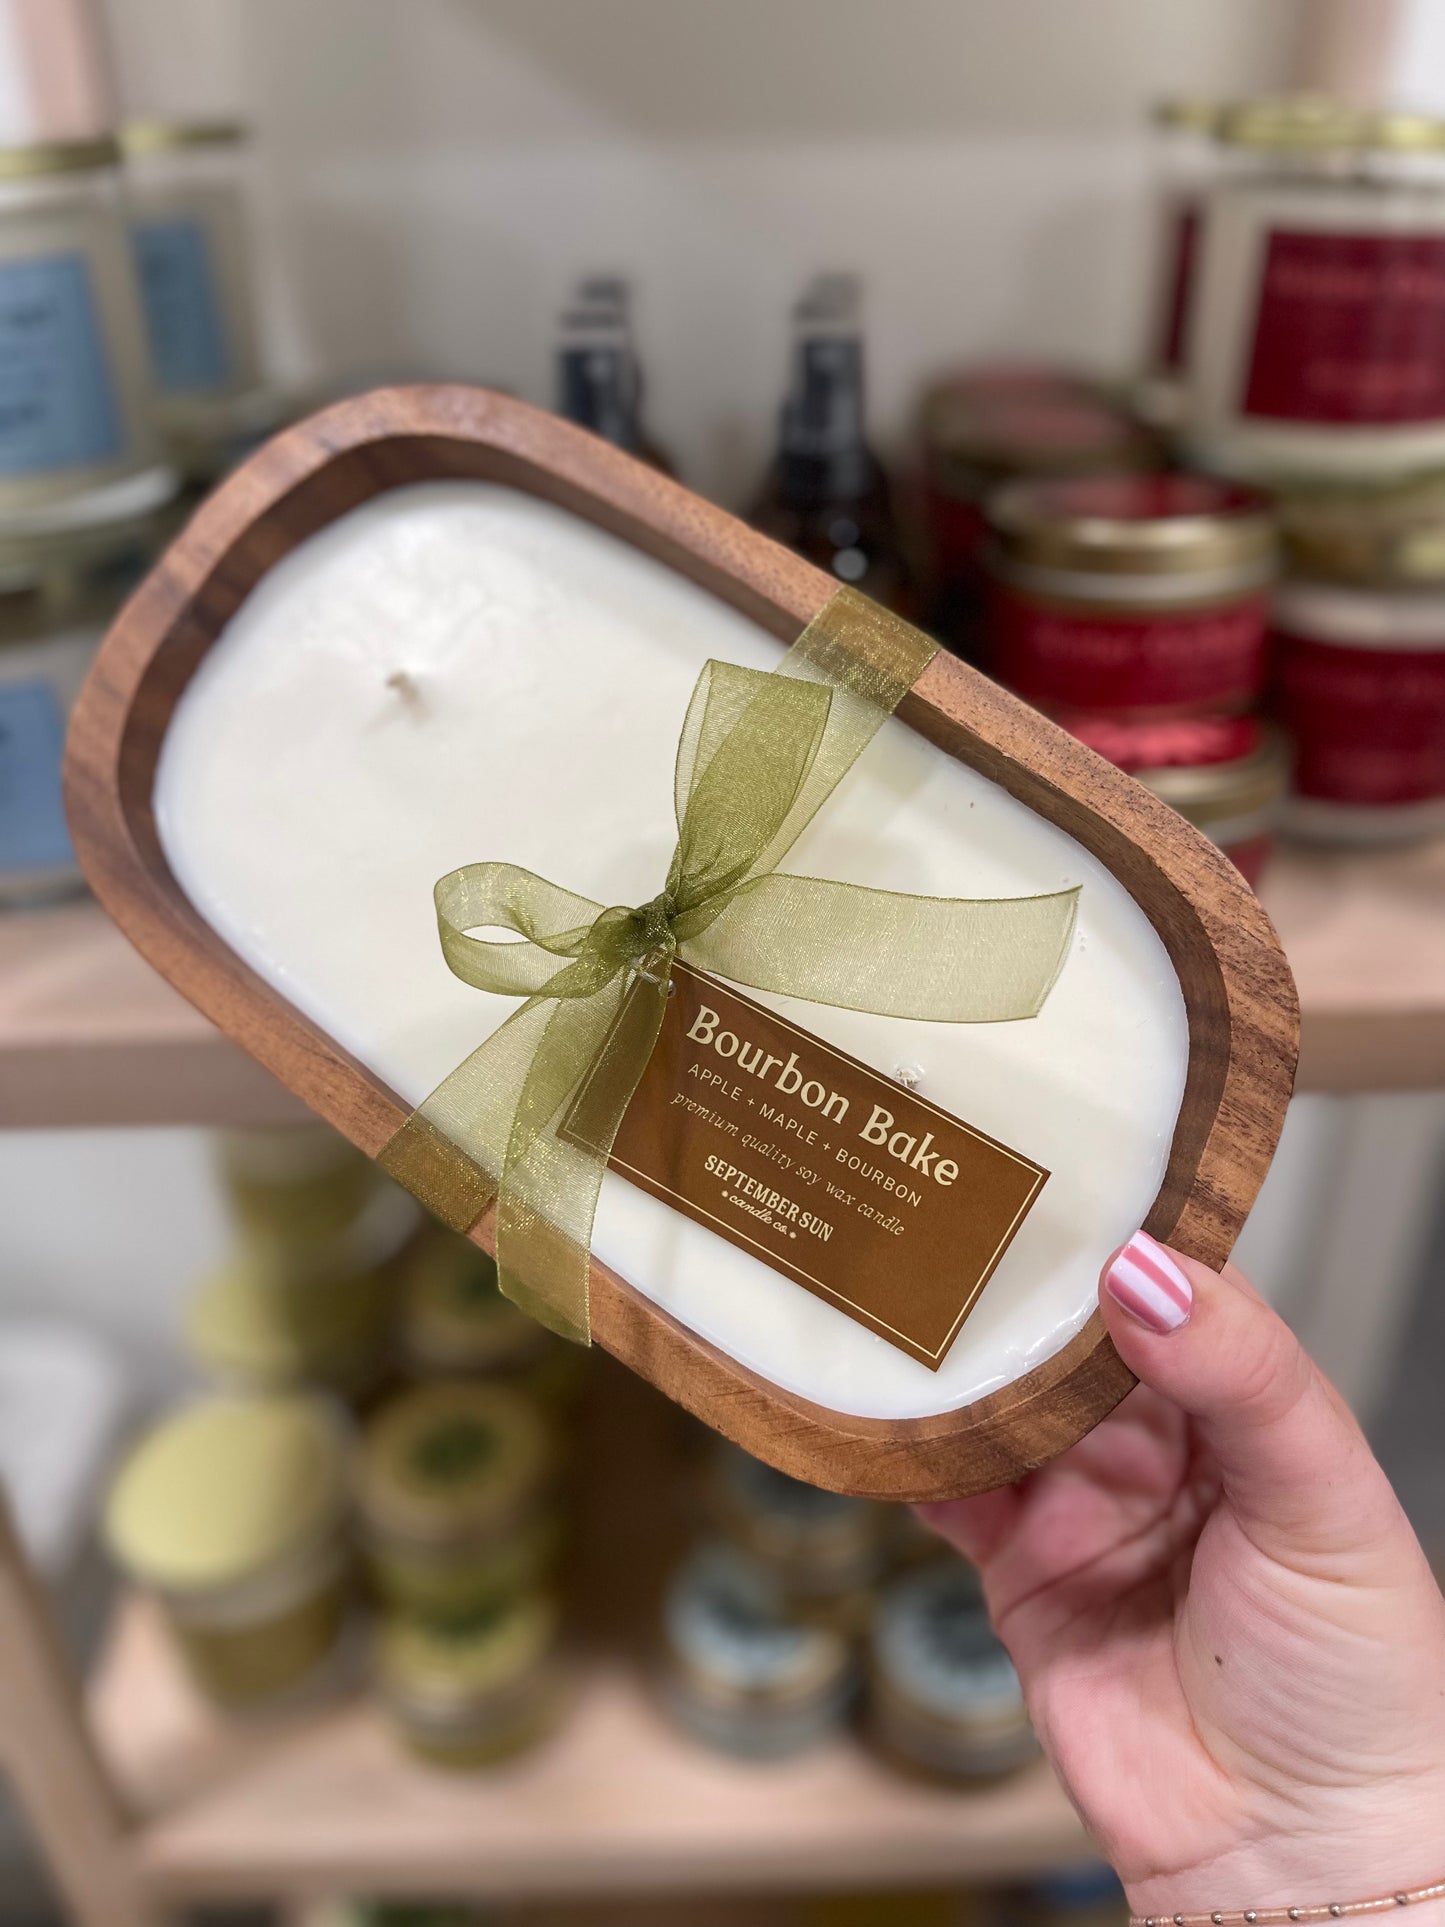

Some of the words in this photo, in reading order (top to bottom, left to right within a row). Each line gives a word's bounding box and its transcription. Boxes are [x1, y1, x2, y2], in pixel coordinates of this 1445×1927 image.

[670, 1092, 739, 1137] premium
[741, 1133, 797, 1170] quality
[796, 1165, 823, 1186] soy
[826, 1181, 856, 1205] wax
[857, 1201, 905, 1236] candle
[686, 1004, 850, 1125] Bourbon
[858, 1104, 960, 1187] Bake
[687, 1063, 743, 1101] APPLE
[759, 1103, 820, 1146] MAPLE
[835, 1148, 922, 1208] BOURBON
[704, 1155, 801, 1223] SEPTEMBER
[799, 1211, 834, 1242] SUN
[729, 1194, 772, 1225] candle
